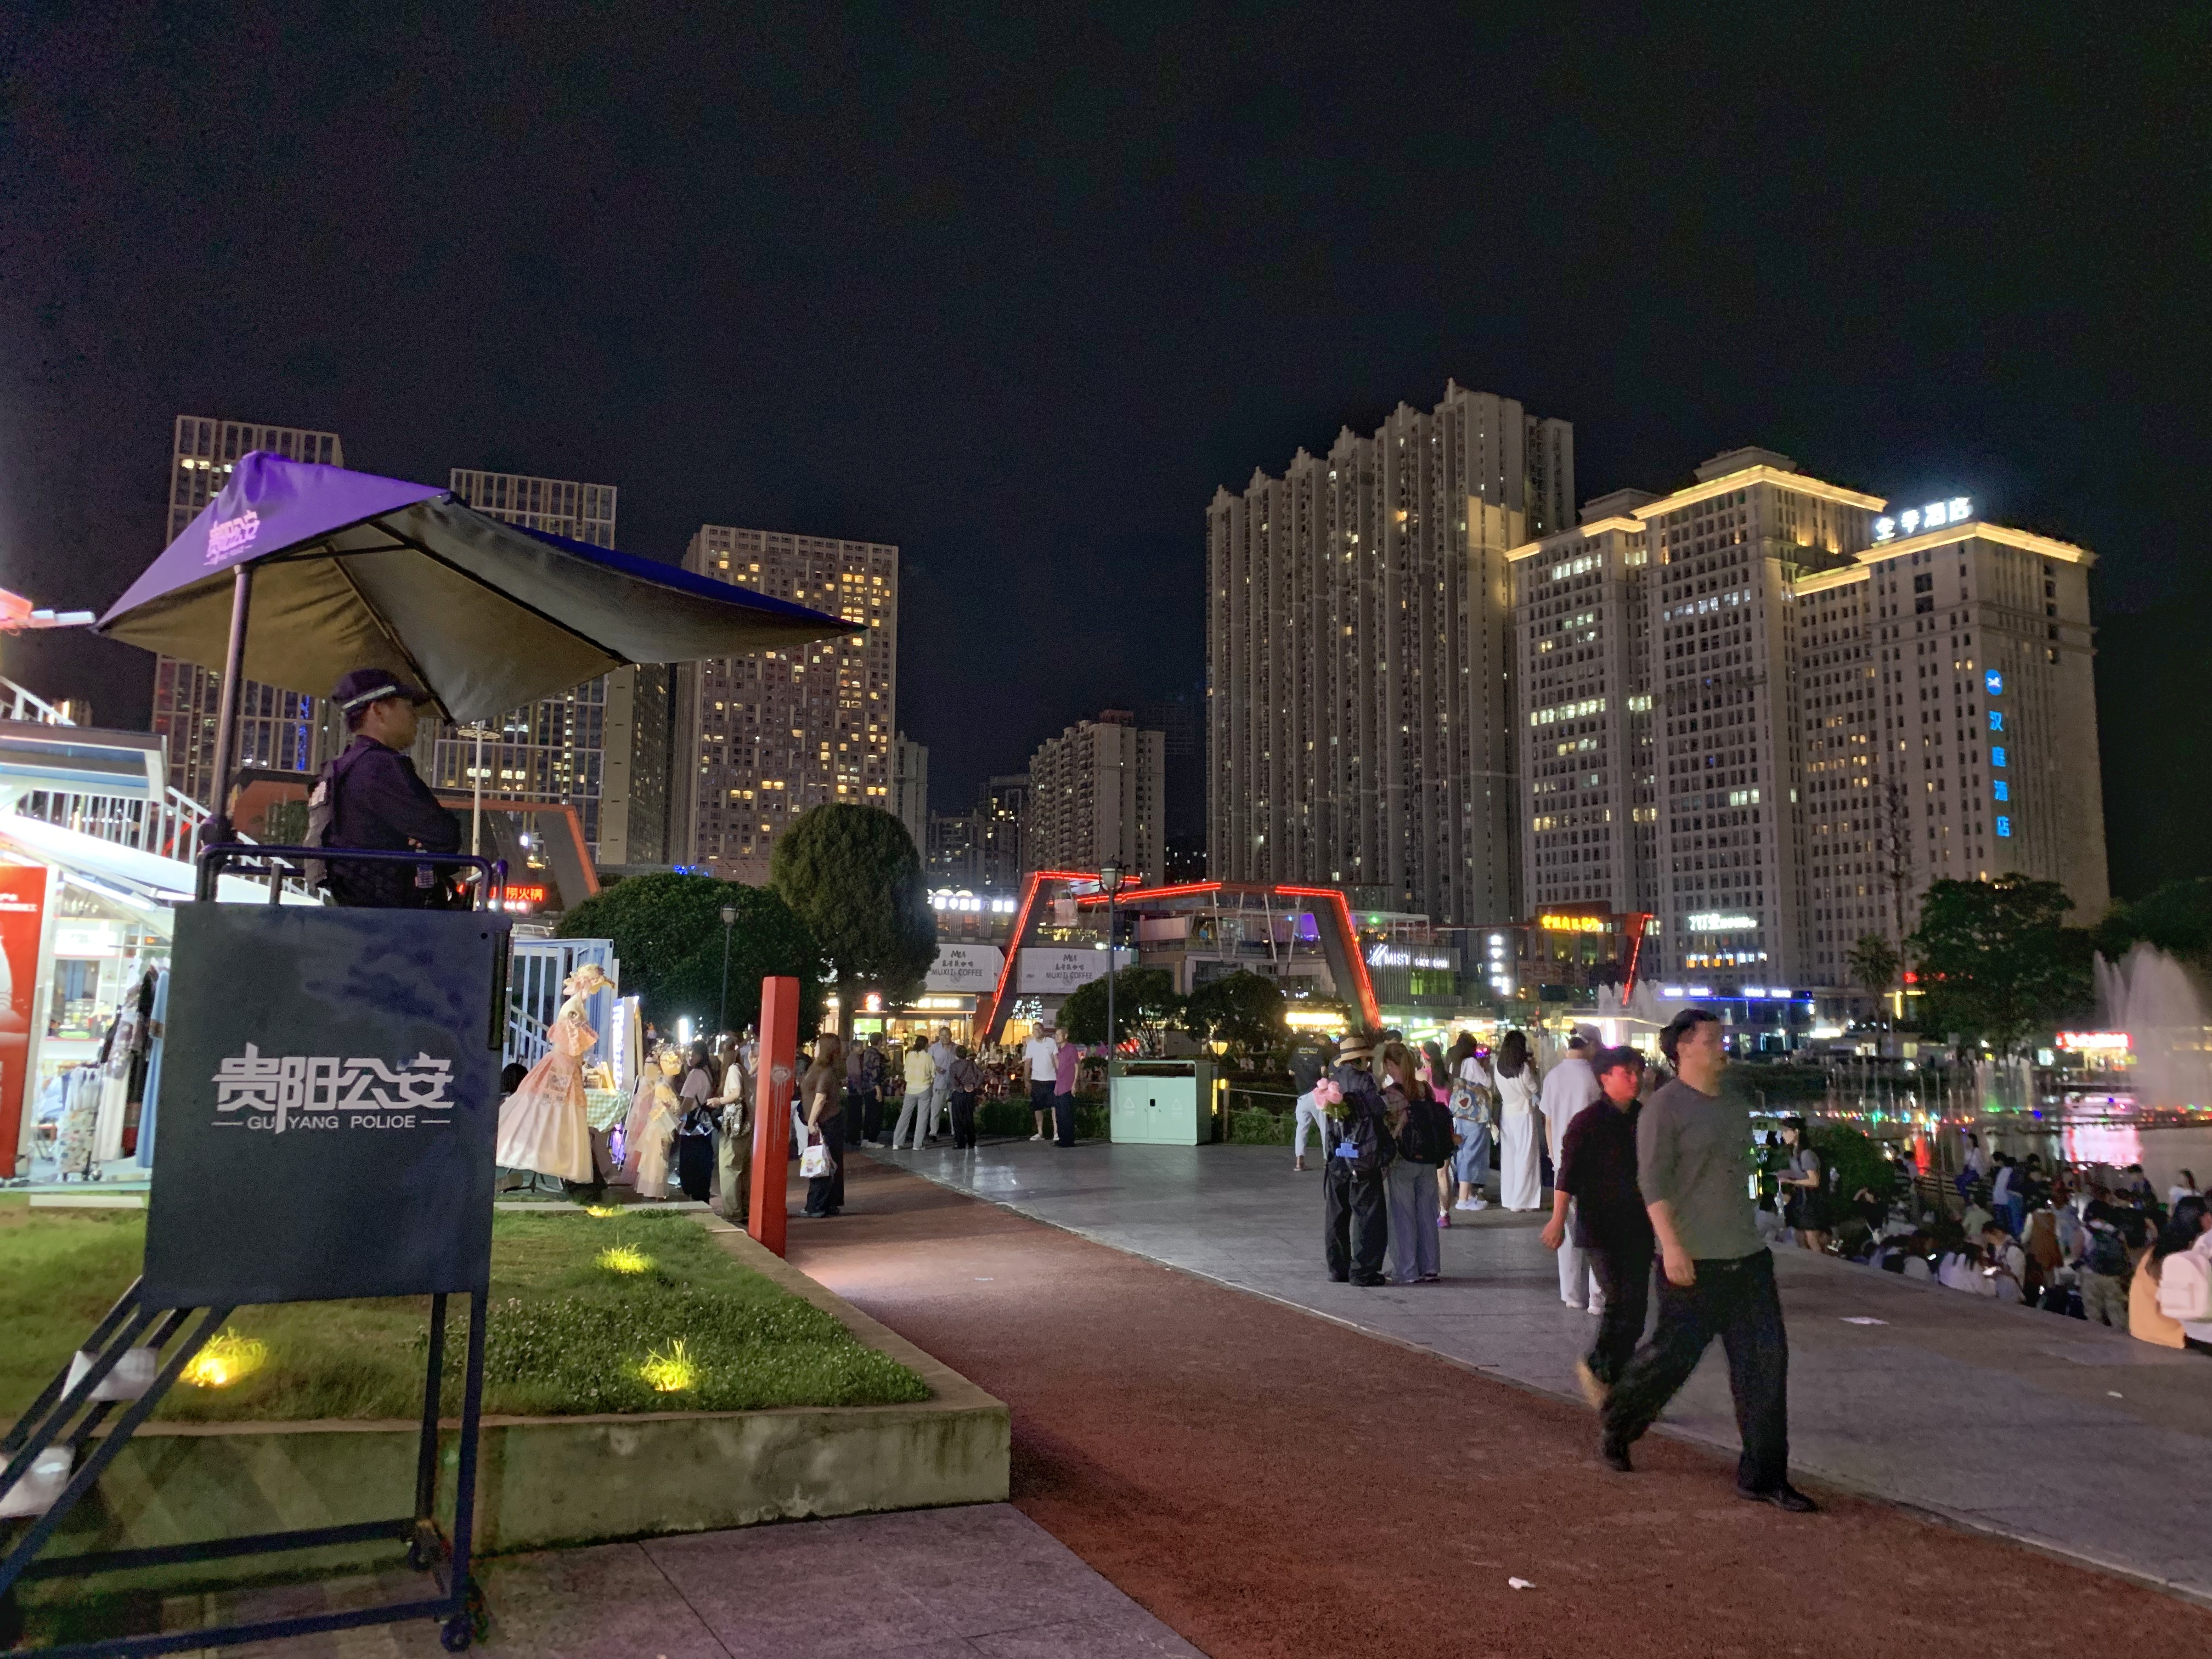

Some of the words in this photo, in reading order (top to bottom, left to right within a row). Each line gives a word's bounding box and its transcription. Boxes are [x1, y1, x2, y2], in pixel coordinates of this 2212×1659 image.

[1875, 497, 1969, 541] 全季酒店
[1989, 710, 2010, 837] 汉庭酒店
[958, 968, 983, 977] COFFEE
[211, 1042, 455, 1134] 贵阳公安
